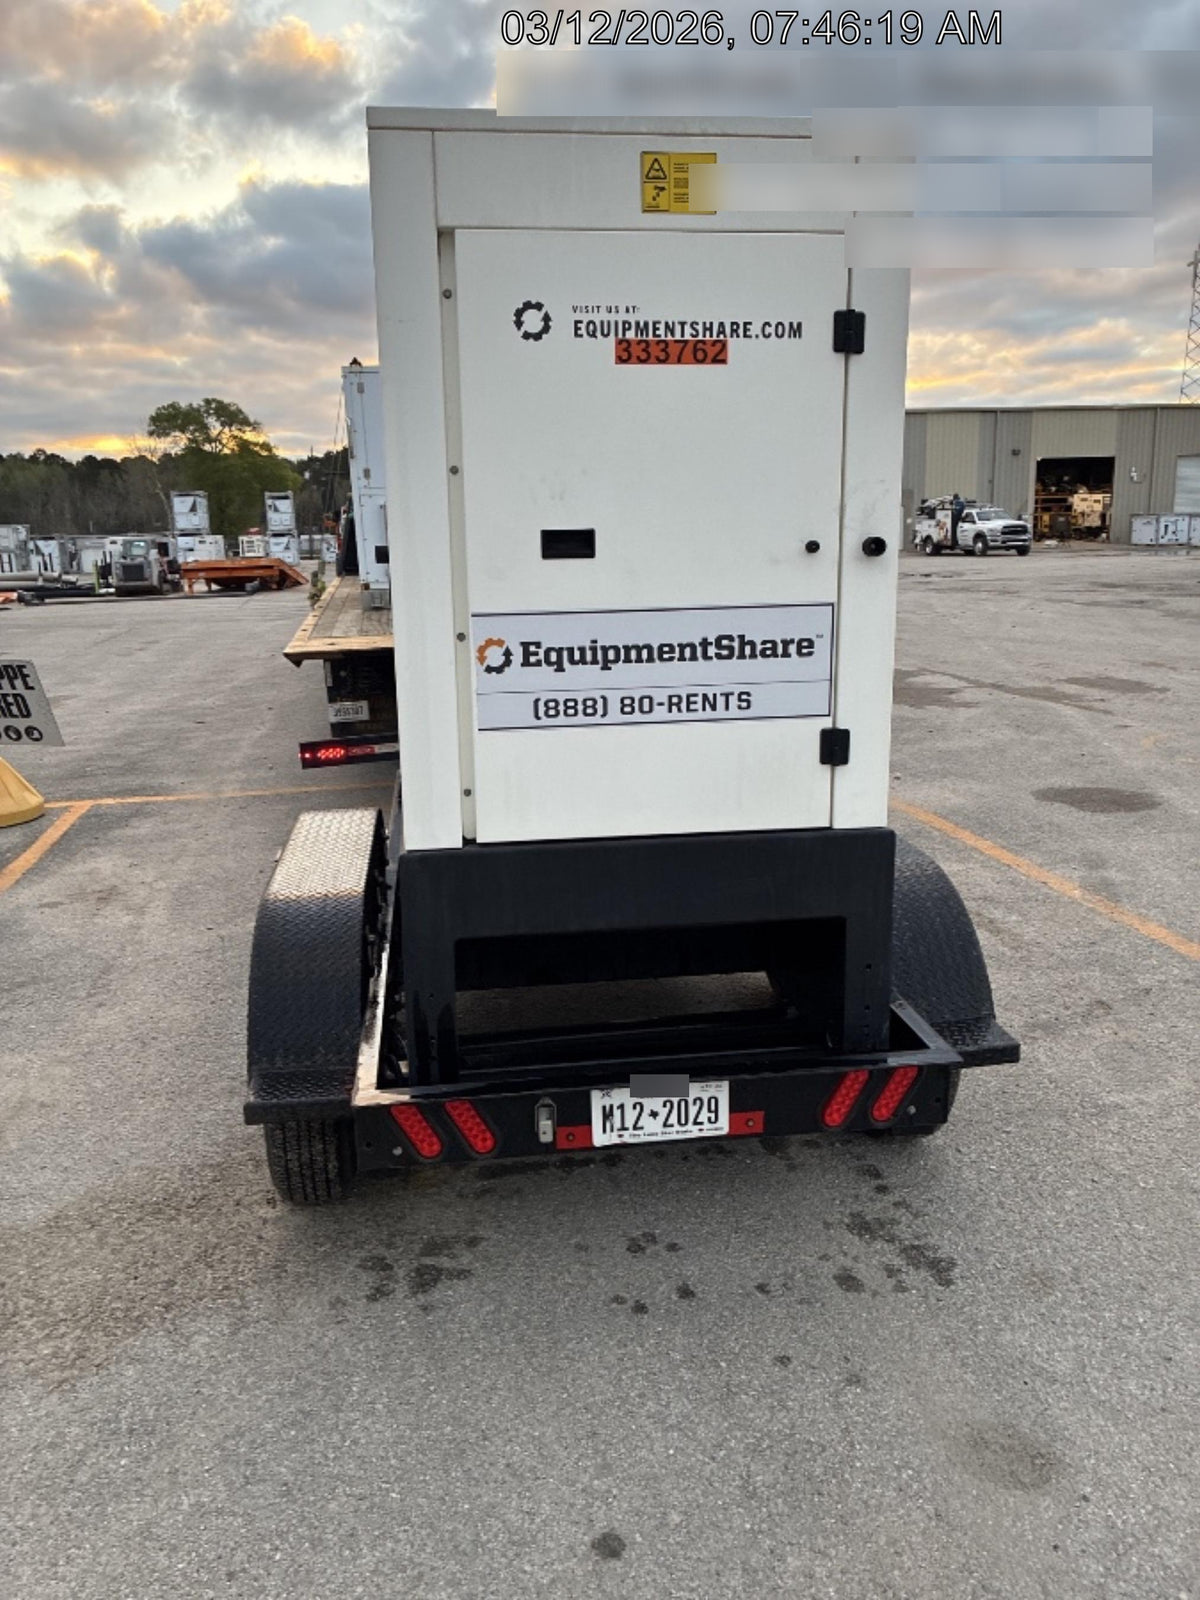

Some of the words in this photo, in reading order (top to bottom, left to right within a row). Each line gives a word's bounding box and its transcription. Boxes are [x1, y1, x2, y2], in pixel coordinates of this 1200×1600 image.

[571, 305, 601, 314] VISIT
[606, 305, 619, 314] US
[573, 319, 803, 340] EQUIPMENTSHARE.COM
[617, 340, 727, 364] 333762
[520, 634, 815, 673] EquipmentShare
[533, 695, 609, 720] (888)
[620, 691, 752, 715] 80-RENTS
[662, 1096, 719, 1128] 2029
